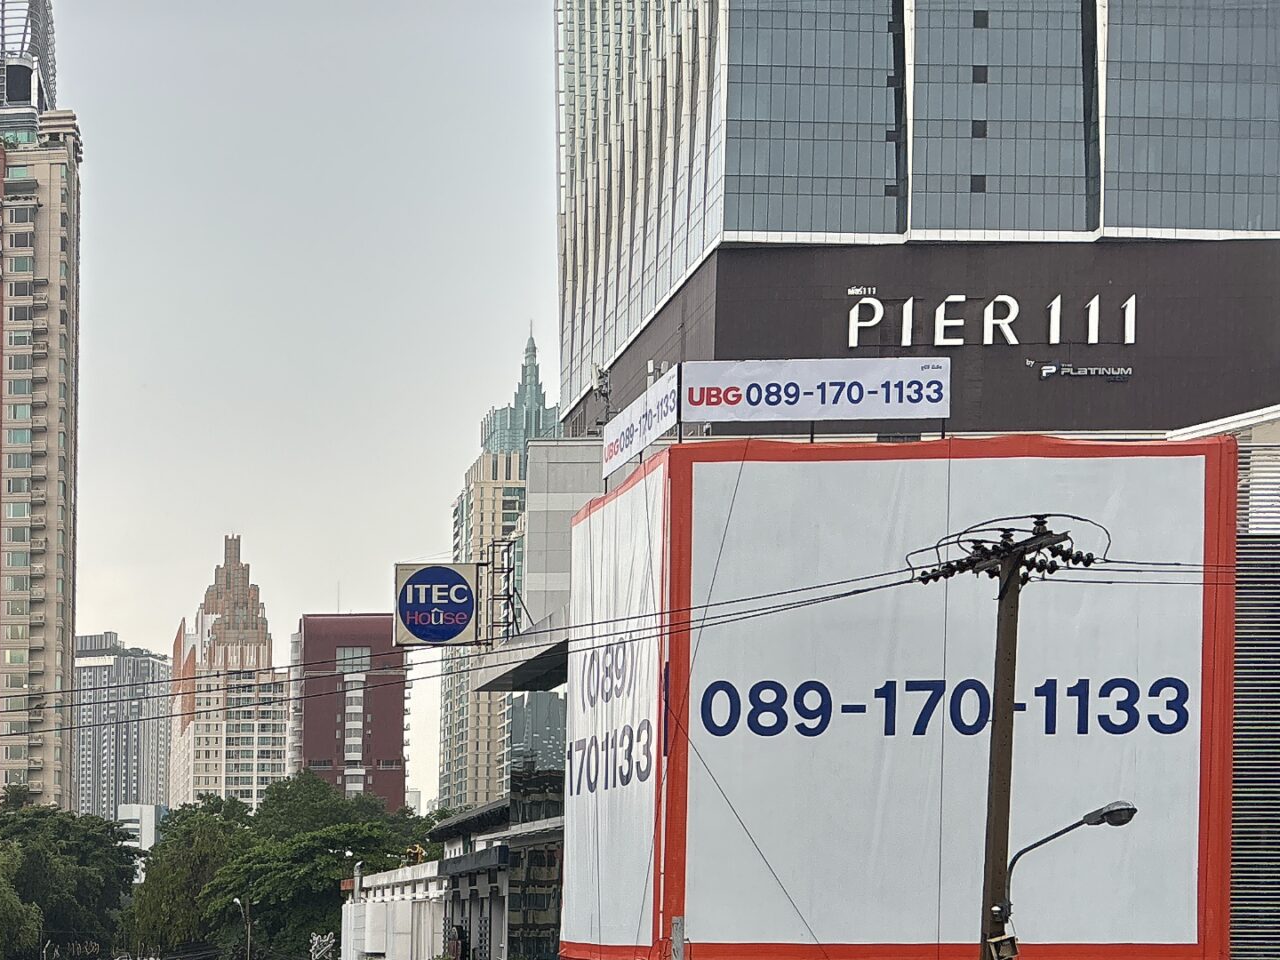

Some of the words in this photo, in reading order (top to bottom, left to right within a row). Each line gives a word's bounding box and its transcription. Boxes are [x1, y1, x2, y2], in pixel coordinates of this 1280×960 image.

[848, 294, 1020, 348] PIER
[1046, 293, 1137, 345] 111
[687, 386, 743, 407] UBG
[745, 379, 945, 407] 089-170-1133
[406, 584, 469, 604] ITEC
[699, 677, 1191, 738] 089-170-1133
